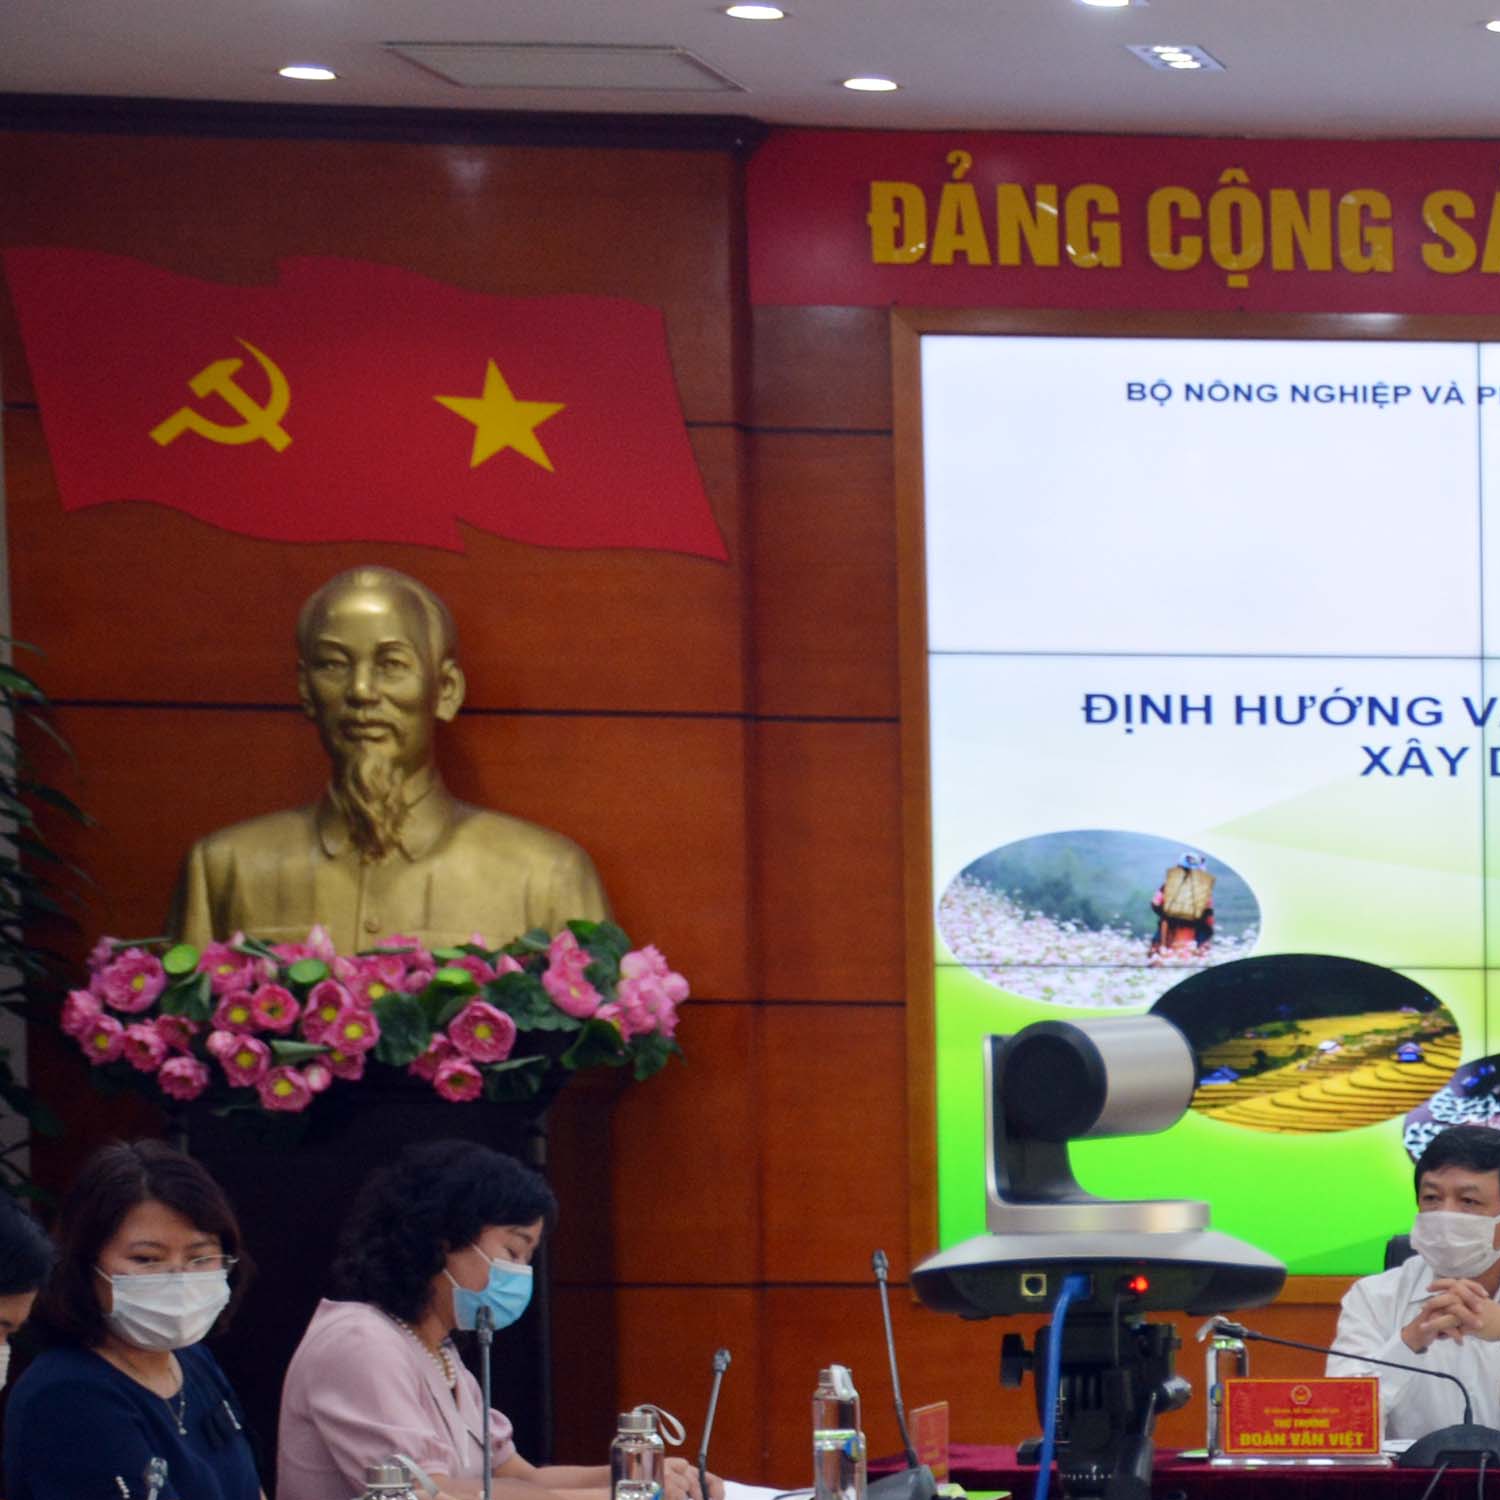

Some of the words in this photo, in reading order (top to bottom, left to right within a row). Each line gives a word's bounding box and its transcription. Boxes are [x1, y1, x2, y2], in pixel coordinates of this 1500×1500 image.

[867, 151, 1121, 268] ĐẢNG
[1148, 168, 1394, 287] CỘNG
[1127, 379, 1173, 407] BỘ
[1184, 380, 1279, 403] NÔNG
[1290, 383, 1413, 409] NGHIỆP
[1422, 382, 1466, 405] VÀ
[1081, 693, 1213, 734] ĐỊNH
[1234, 687, 1444, 727] HƯỚNG
[1360, 738, 1470, 777] XÂY
